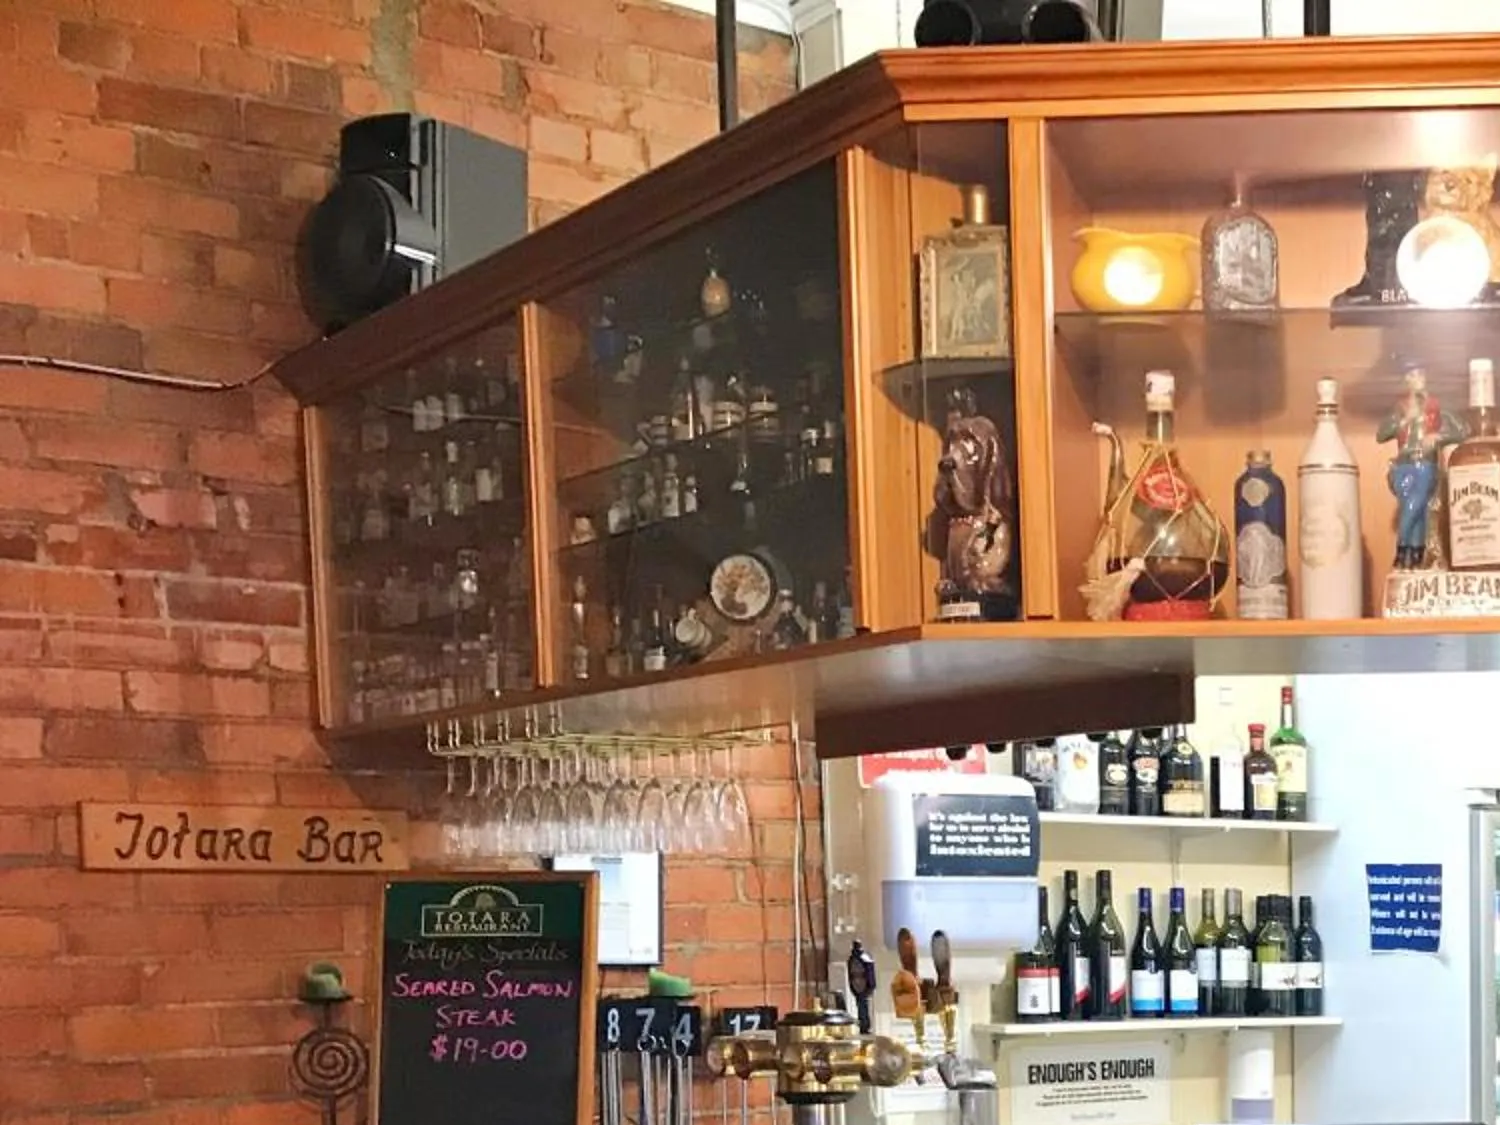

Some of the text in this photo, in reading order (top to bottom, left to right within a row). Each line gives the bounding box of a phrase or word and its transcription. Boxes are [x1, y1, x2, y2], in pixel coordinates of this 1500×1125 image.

[1451, 481, 1499, 506] JIM BEAM
[1401, 576, 1439, 606] JIM
[434, 910, 532, 924] TOTARA
[480, 938, 569, 965] Specials
[392, 968, 574, 999] SEARED SALMON
[435, 1004, 517, 1029] STEAK
[606, 1007, 621, 1043] 8
[635, 1007, 656, 1038] 7
[674, 1013, 695, 1044] 4
[728, 1014, 761, 1036] 17
[1027, 1057, 1155, 1085] ENOUGH'S ENOUGH
